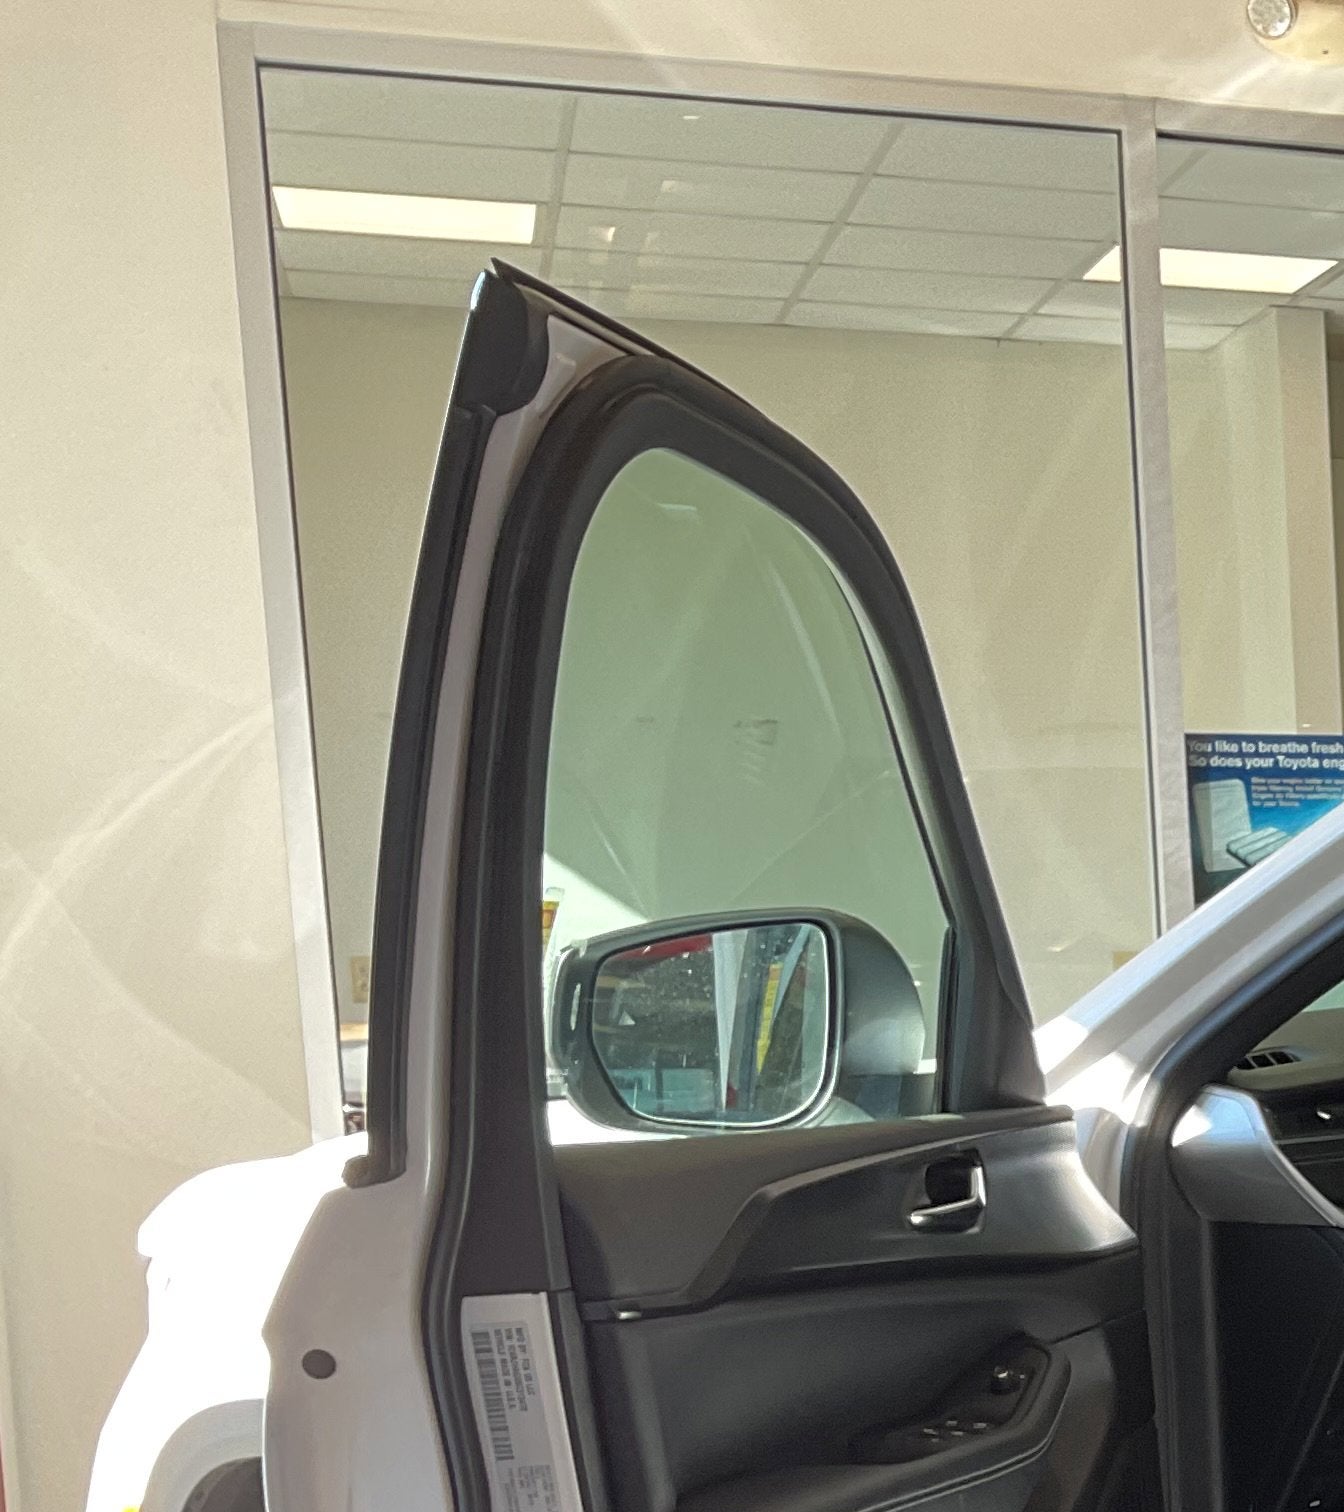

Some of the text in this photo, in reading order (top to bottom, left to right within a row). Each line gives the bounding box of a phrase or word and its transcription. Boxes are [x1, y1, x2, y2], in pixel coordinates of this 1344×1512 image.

[1188, 741, 1211, 752] You
[1215, 740, 1239, 752] like
[1241, 741, 1256, 753] to
[1258, 741, 1309, 754] breathe
[1311, 742, 1344, 754] fresh
[1188, 756, 1207, 767] So
[1209, 755, 1243, 767] does
[1244, 757, 1275, 770] your
[1276, 755, 1320, 770] Toyota
